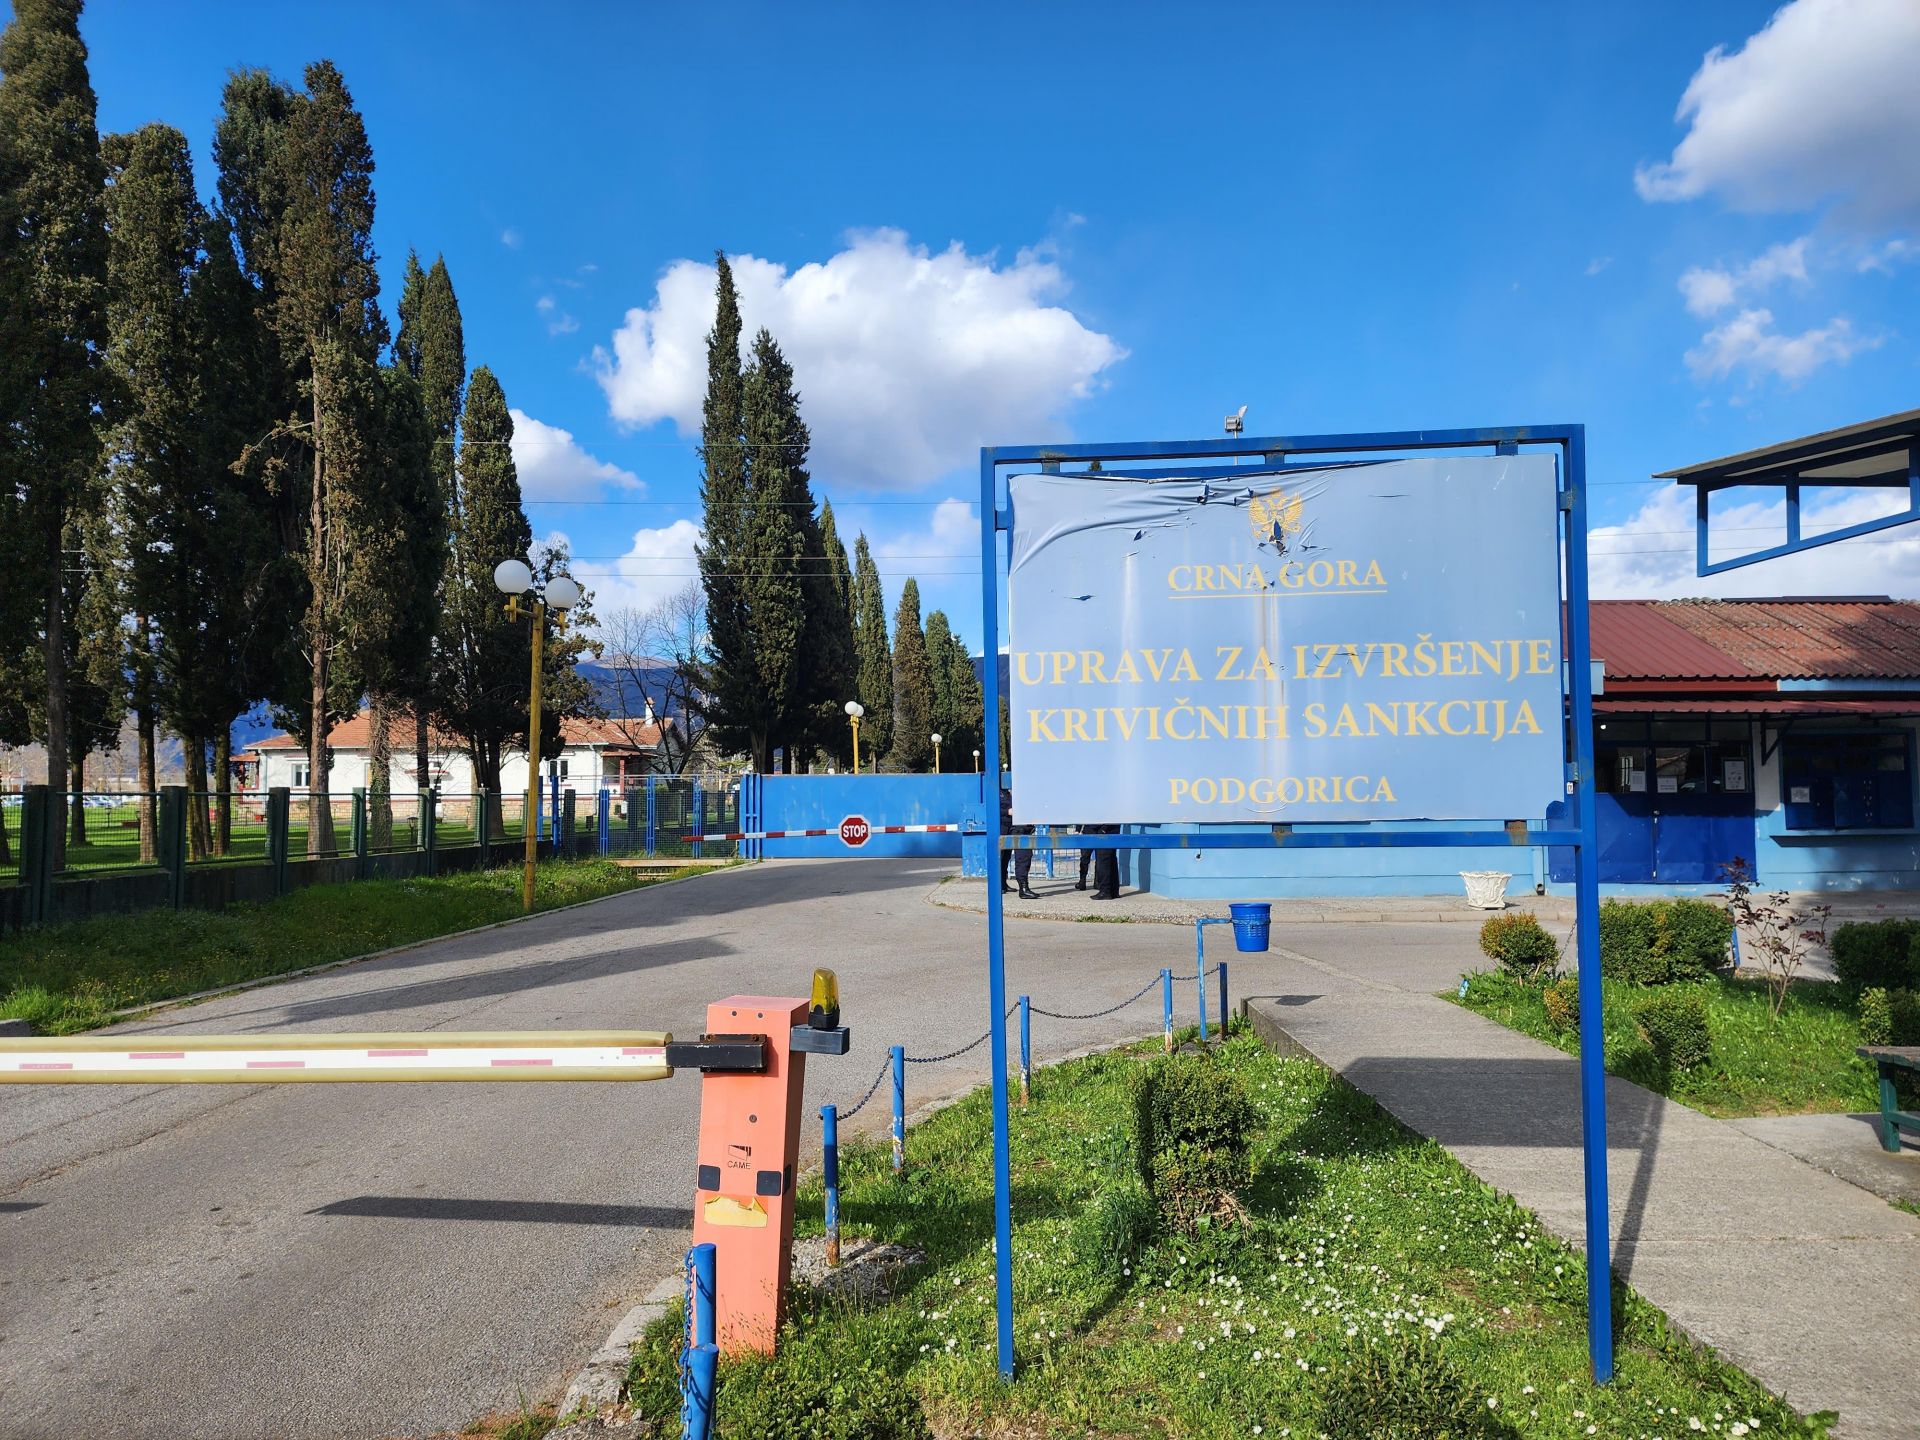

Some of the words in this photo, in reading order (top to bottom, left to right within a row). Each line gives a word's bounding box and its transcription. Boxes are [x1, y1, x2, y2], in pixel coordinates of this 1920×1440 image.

[1168, 563, 1268, 592] CRNA
[1279, 559, 1388, 589] GORA
[1014, 647, 1202, 686] UPRAVA
[1215, 646, 1281, 682] ZA
[1292, 633, 1555, 682] IZVRŠENJE
[1027, 697, 1290, 742] KRIVIČNIH
[1303, 699, 1544, 742] SANKCIJA
[1168, 775, 1398, 804] PODGORICA
[843, 824, 867, 837] STOP
[727, 1160, 751, 1169] CAME
